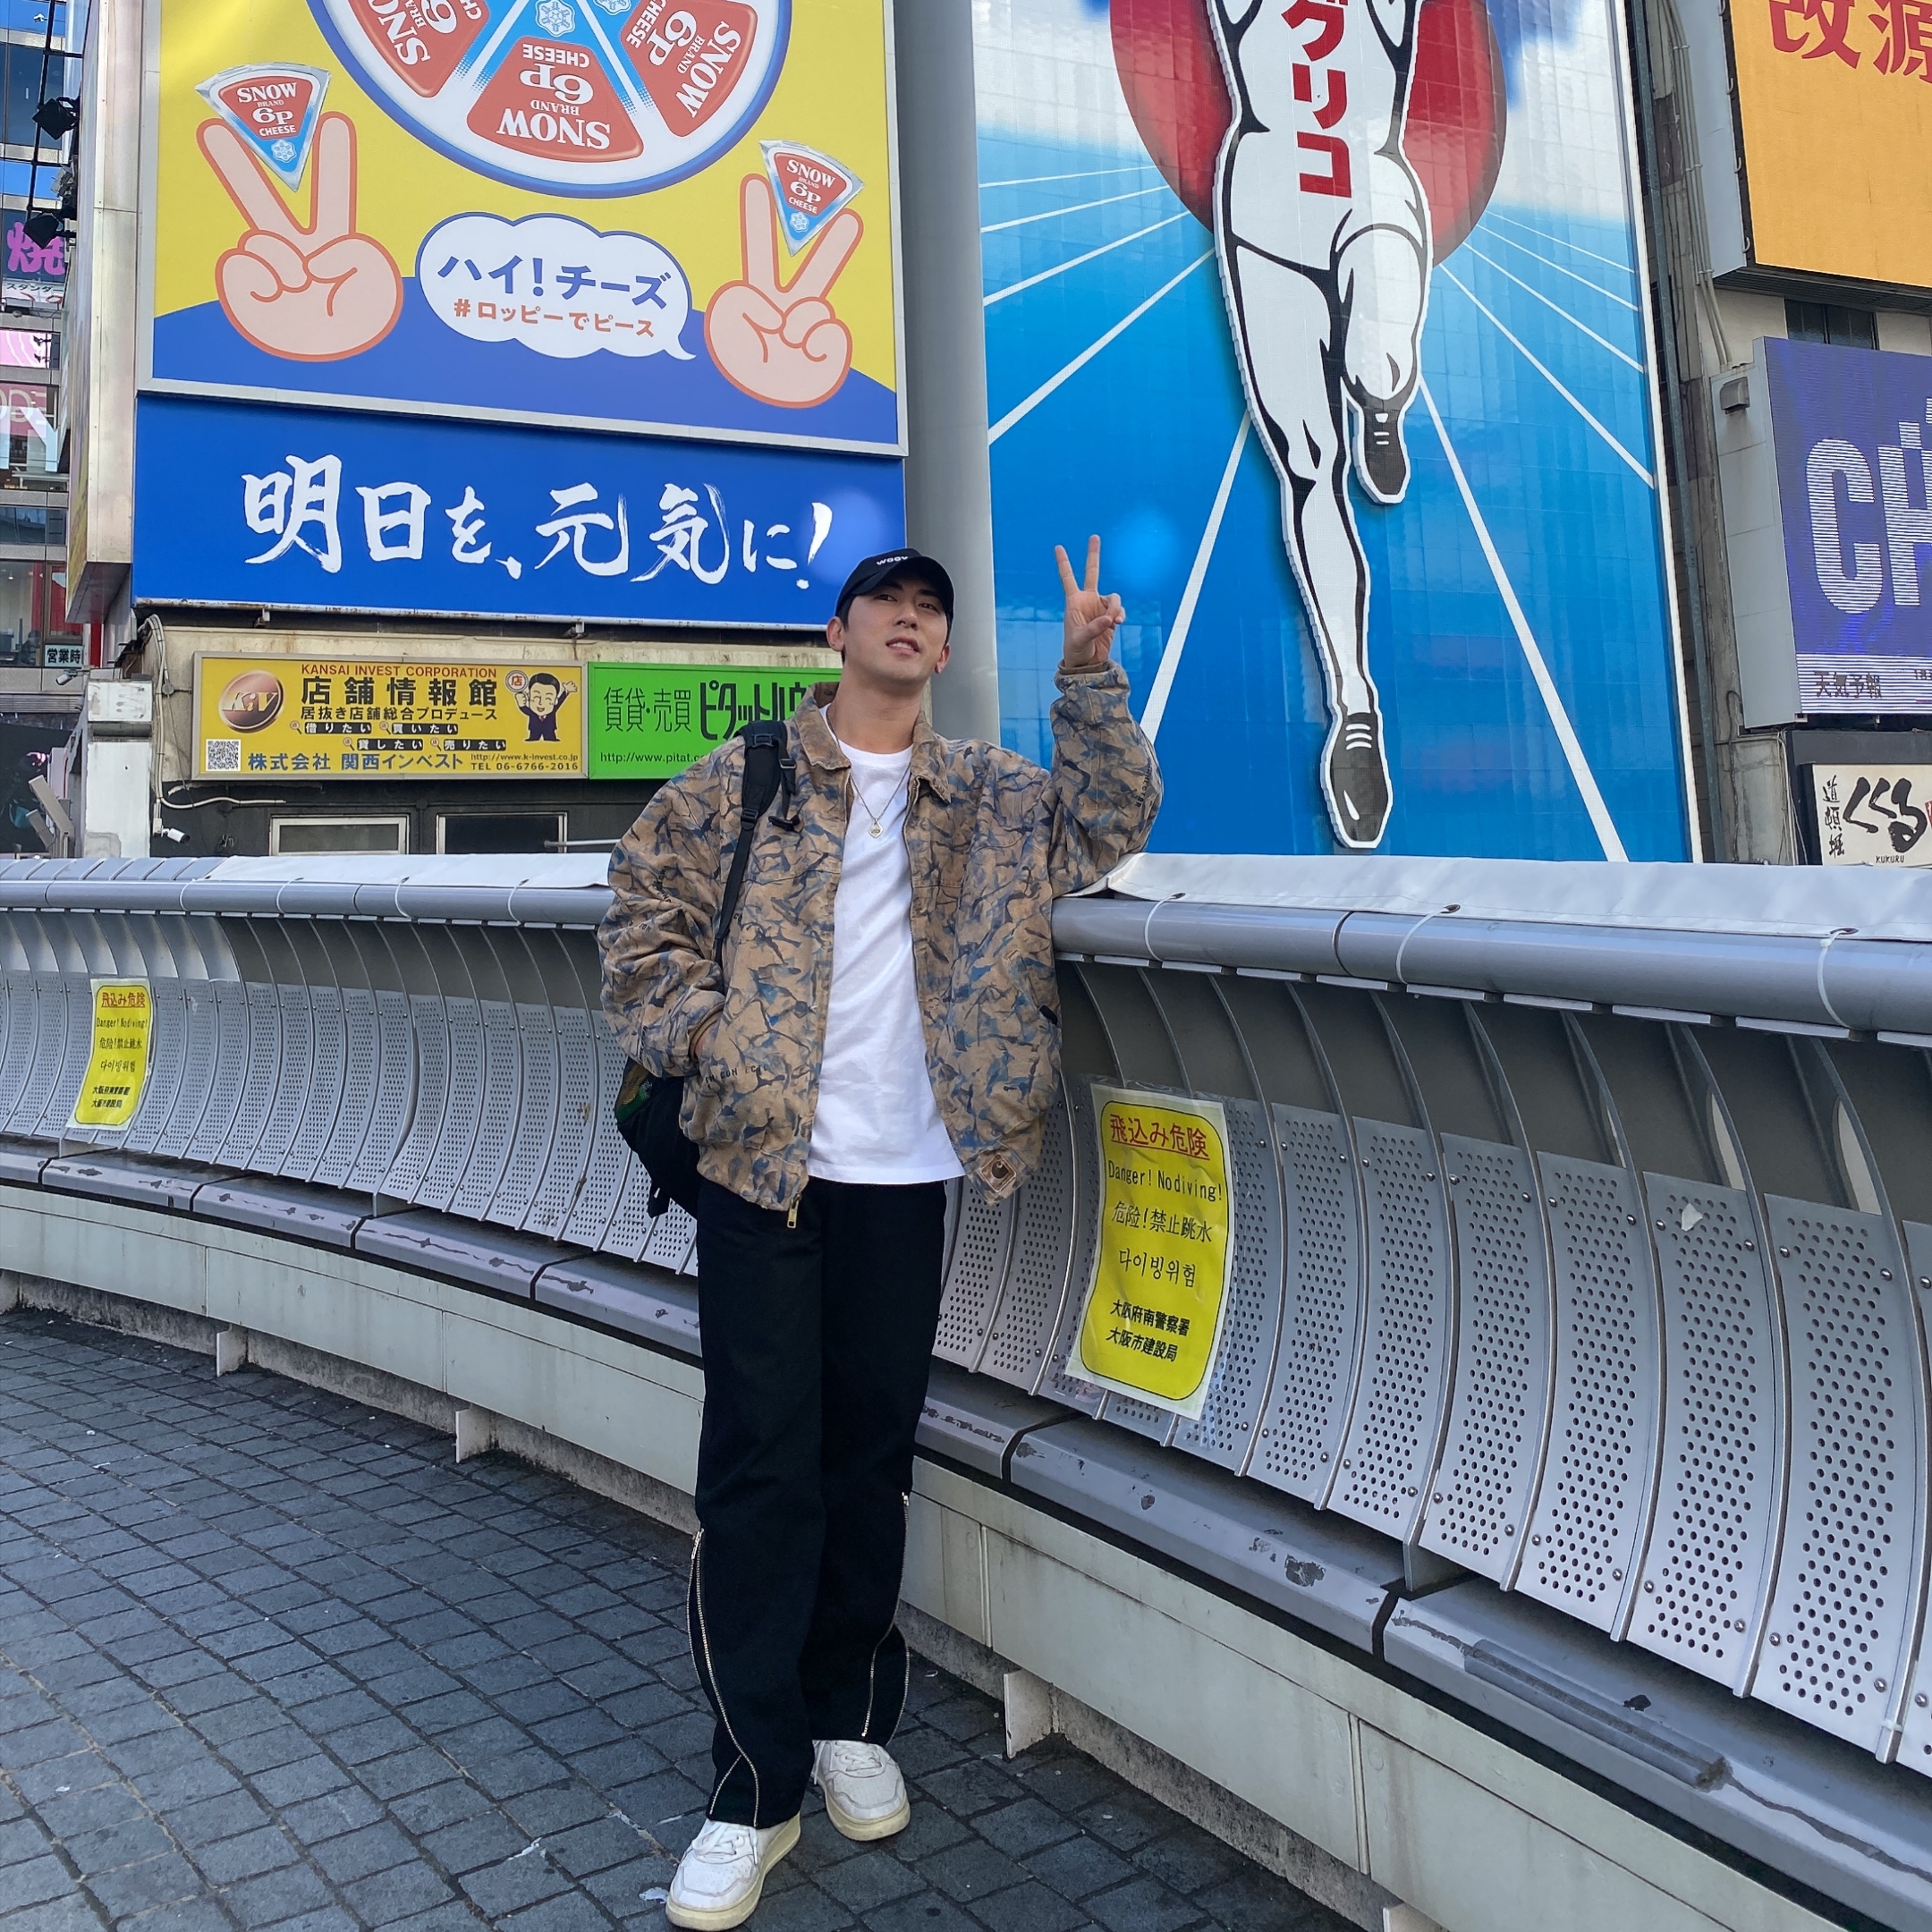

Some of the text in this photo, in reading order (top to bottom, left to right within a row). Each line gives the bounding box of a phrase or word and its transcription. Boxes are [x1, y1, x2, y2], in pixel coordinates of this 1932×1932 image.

[646, 10, 697, 66] 6P
[523, 44, 590, 68] CHEESE
[677, 35, 705, 73] BRAND
[675, 21, 741, 118] SNOW
[236, 82, 297, 103] SNOW
[520, 63, 594, 105] 6P
[257, 99, 284, 107] BRAND
[530, 100, 580, 116] BRAND
[1282, 0, 1352, 198] グリコ
[252, 107, 293, 125] 6P
[259, 125, 296, 137] CHEESE
[496, 108, 611, 150] SNOW
[786, 159, 836, 188] SNOW
[790, 181, 821, 204] 6P
[788, 196, 818, 214] CHEESE
[47, 648, 81, 664] 営業時
[301, 664, 497, 678] KANSAI INVEST CORPORATION
[511, 674, 523, 686] 店
[301, 676, 497, 707] 店舗情報館
[1814, 671, 1882, 699] 天気予報
[301, 706, 497, 721] 居抜き店舗総合プロデュース
[305, 723, 371, 733] 借りたい
[392, 724, 458, 734] 買いたい
[444, 740, 506, 750] 売りたい
[248, 752, 463, 771] 株式会社 関西インベスト
[470, 753, 579, 762] http://www.k-invest.co.jp
[471, 762, 579, 771] TEL 06-6766-2016
[600, 751, 705, 764] http://www.pitat.c
[1843, 776, 1928, 853] くくる
[1876, 855, 1905, 864] KUKURU
[101, 992, 146, 1008] 飛込み危険
[1109, 1114, 1209, 1159] 飛込み危険
[1108, 1160, 1152, 1186] Danger!
[1119, 1248, 1196, 1288] 다이빙위험
[1110, 1299, 1191, 1336] 大阪府南警察署
[1106, 1326, 1178, 1362] 大阪市建設局
